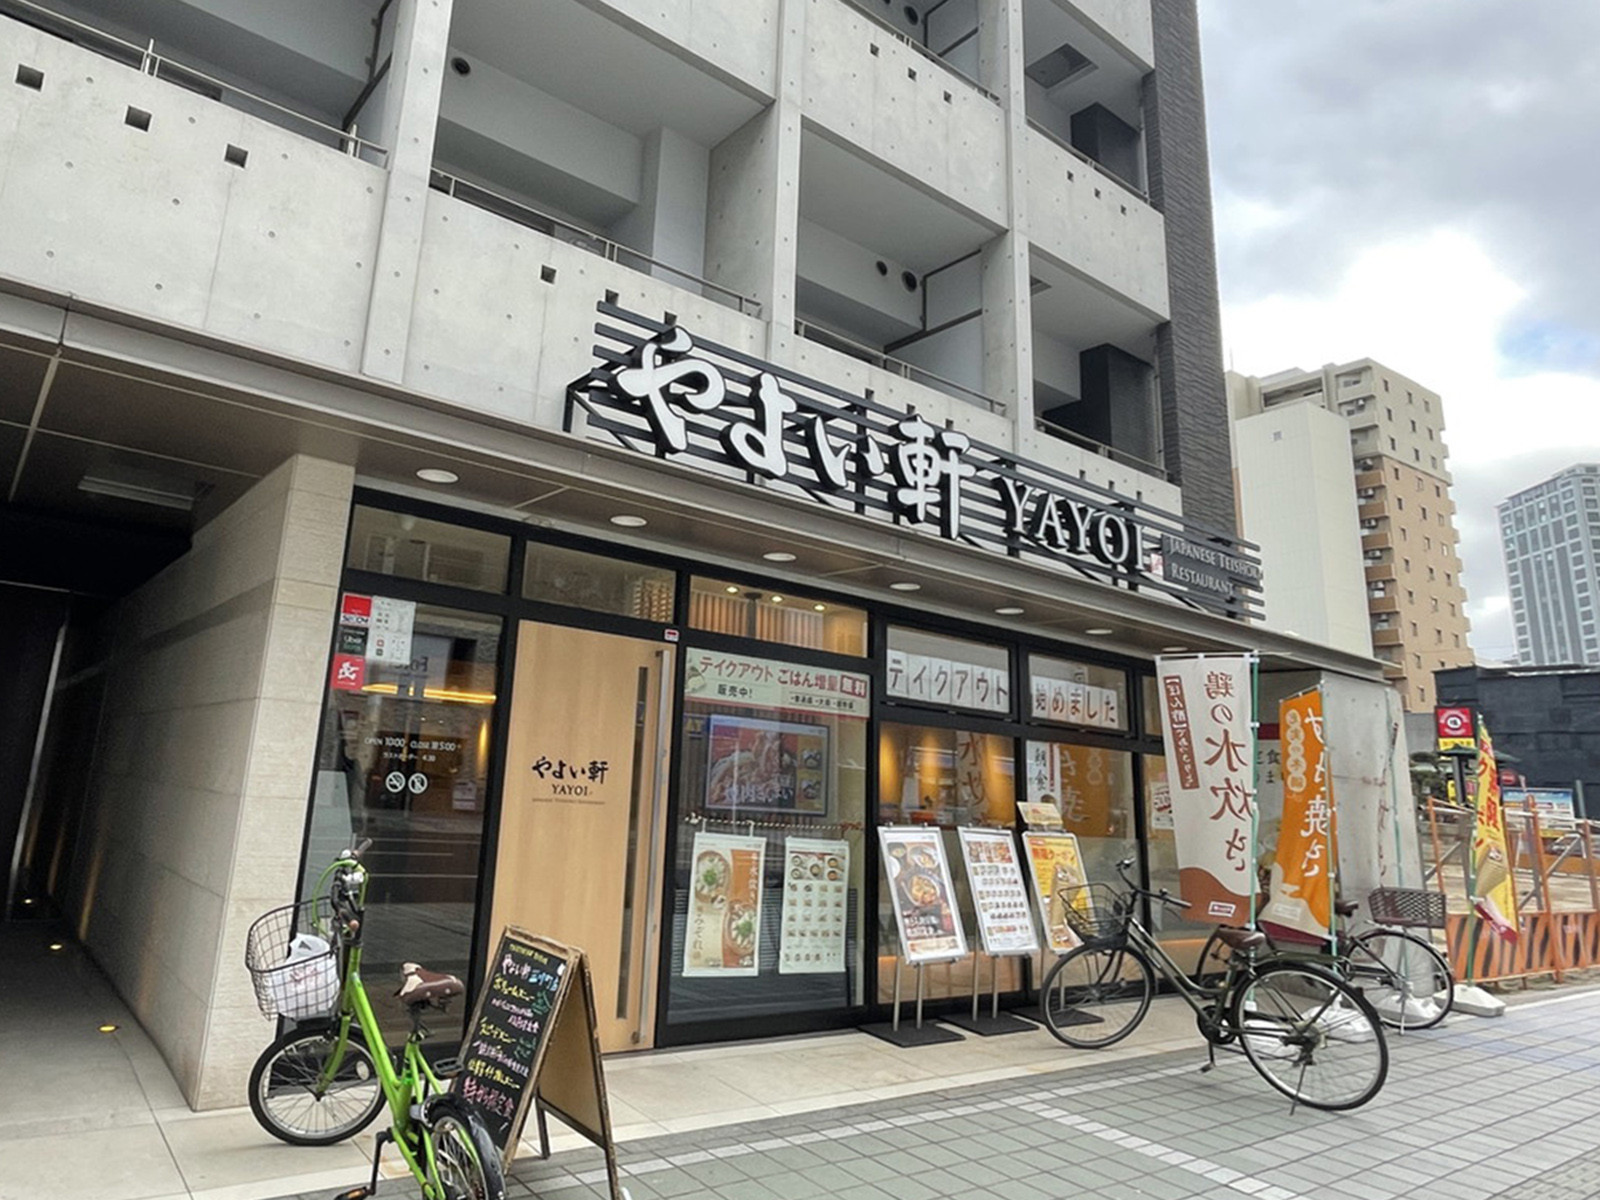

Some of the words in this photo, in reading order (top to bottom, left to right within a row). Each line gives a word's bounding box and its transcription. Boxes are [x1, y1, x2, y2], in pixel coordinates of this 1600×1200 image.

[615, 326, 976, 540] やよい軒
[1002, 476, 1147, 571] YAYOI
[1169, 537, 1217, 565] JAPANESE
[1171, 562, 1235, 595] RESTAURANT
[701, 656, 774, 683] テイクアウト
[889, 658, 1009, 706] テイクアウト
[1034, 683, 1116, 724] 始めました
[532, 756, 609, 784] やよい軒
[552, 783, 588, 796] YAYOI
